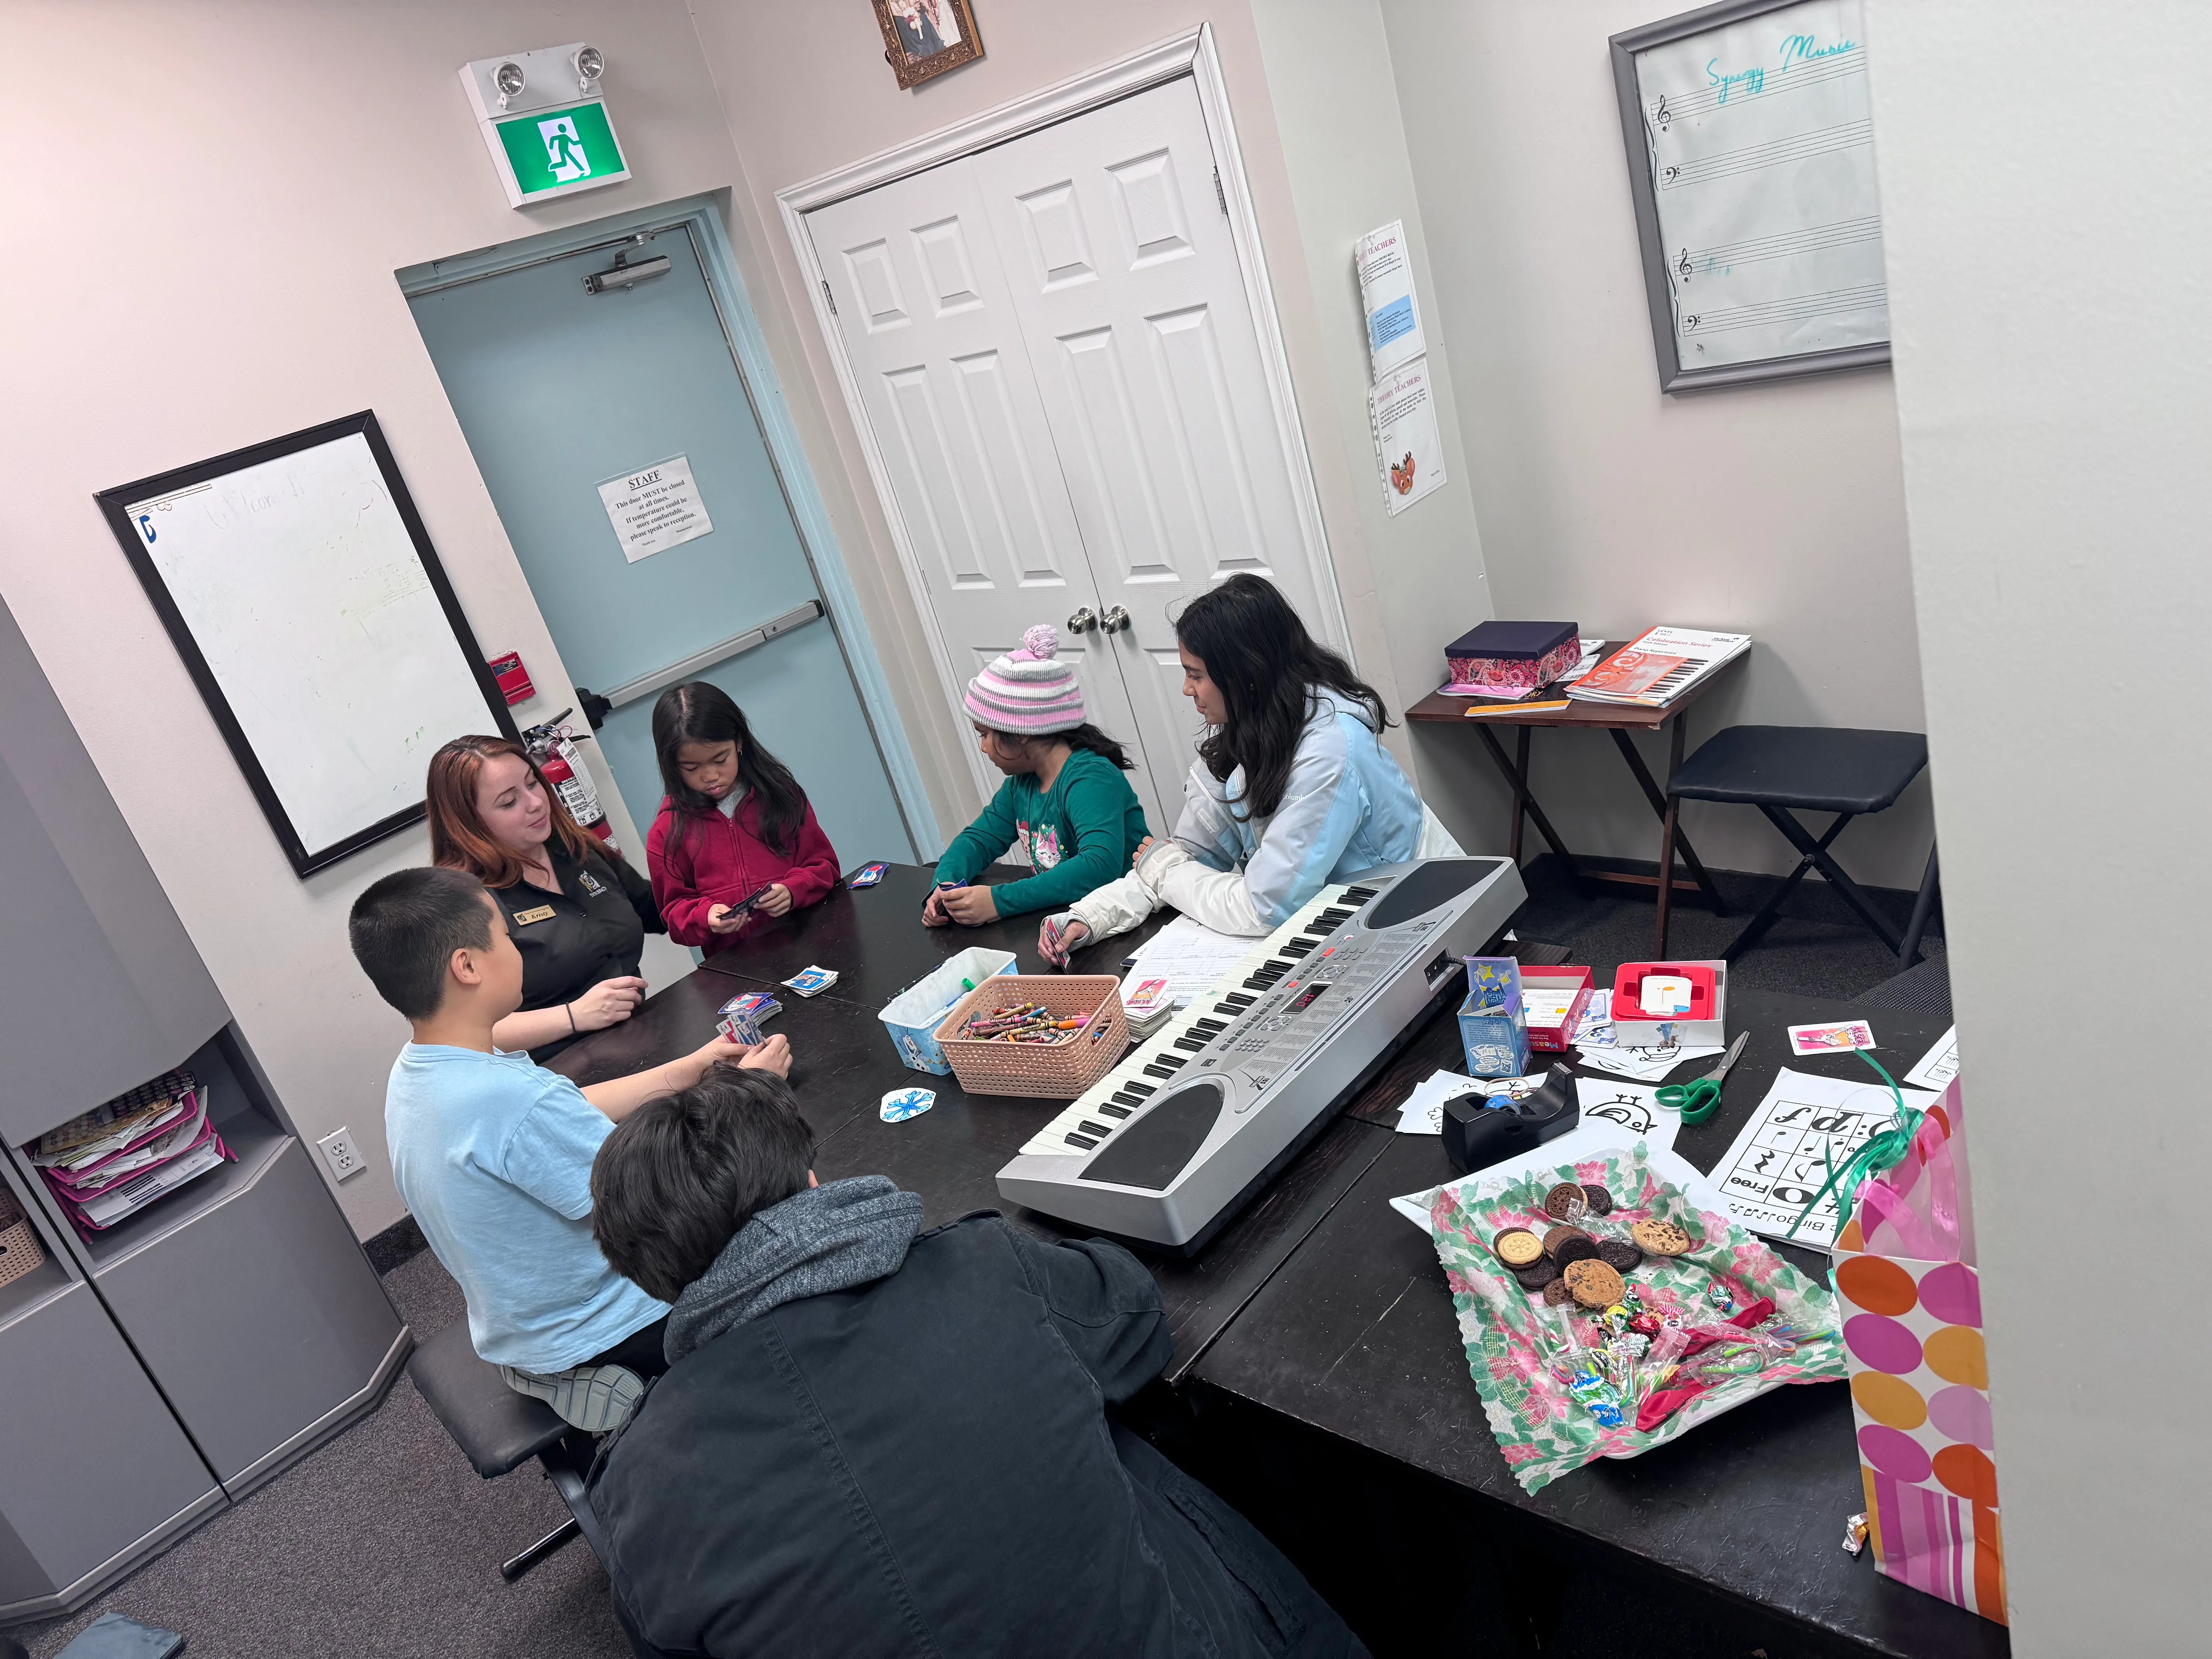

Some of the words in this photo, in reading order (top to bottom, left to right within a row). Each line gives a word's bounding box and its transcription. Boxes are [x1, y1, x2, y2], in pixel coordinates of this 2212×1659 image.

[1707, 58, 1764, 105] Synergy
[1779, 34, 1856, 72] Music
[1367, 237, 1396, 255] TEACHERS
[1377, 389, 1393, 404] THEORY
[1395, 375, 1421, 393] TEACHERS
[629, 470, 659, 488] STAFF
[642, 488, 659, 499] MUST
[669, 480, 685, 489] closed
[632, 506, 665, 521] temperature
[666, 499, 680, 508] could
[651, 508, 684, 523] comfortable,
[630, 531, 646, 541] please
[647, 524, 663, 534] speak
[670, 513, 696, 525] reception.
[1647, 637, 1689, 646] Celebration
[531, 911, 548, 919] Kristy
[1730, 1177, 1769, 1194] Free
[1776, 1215, 1825, 1231] Bingo
